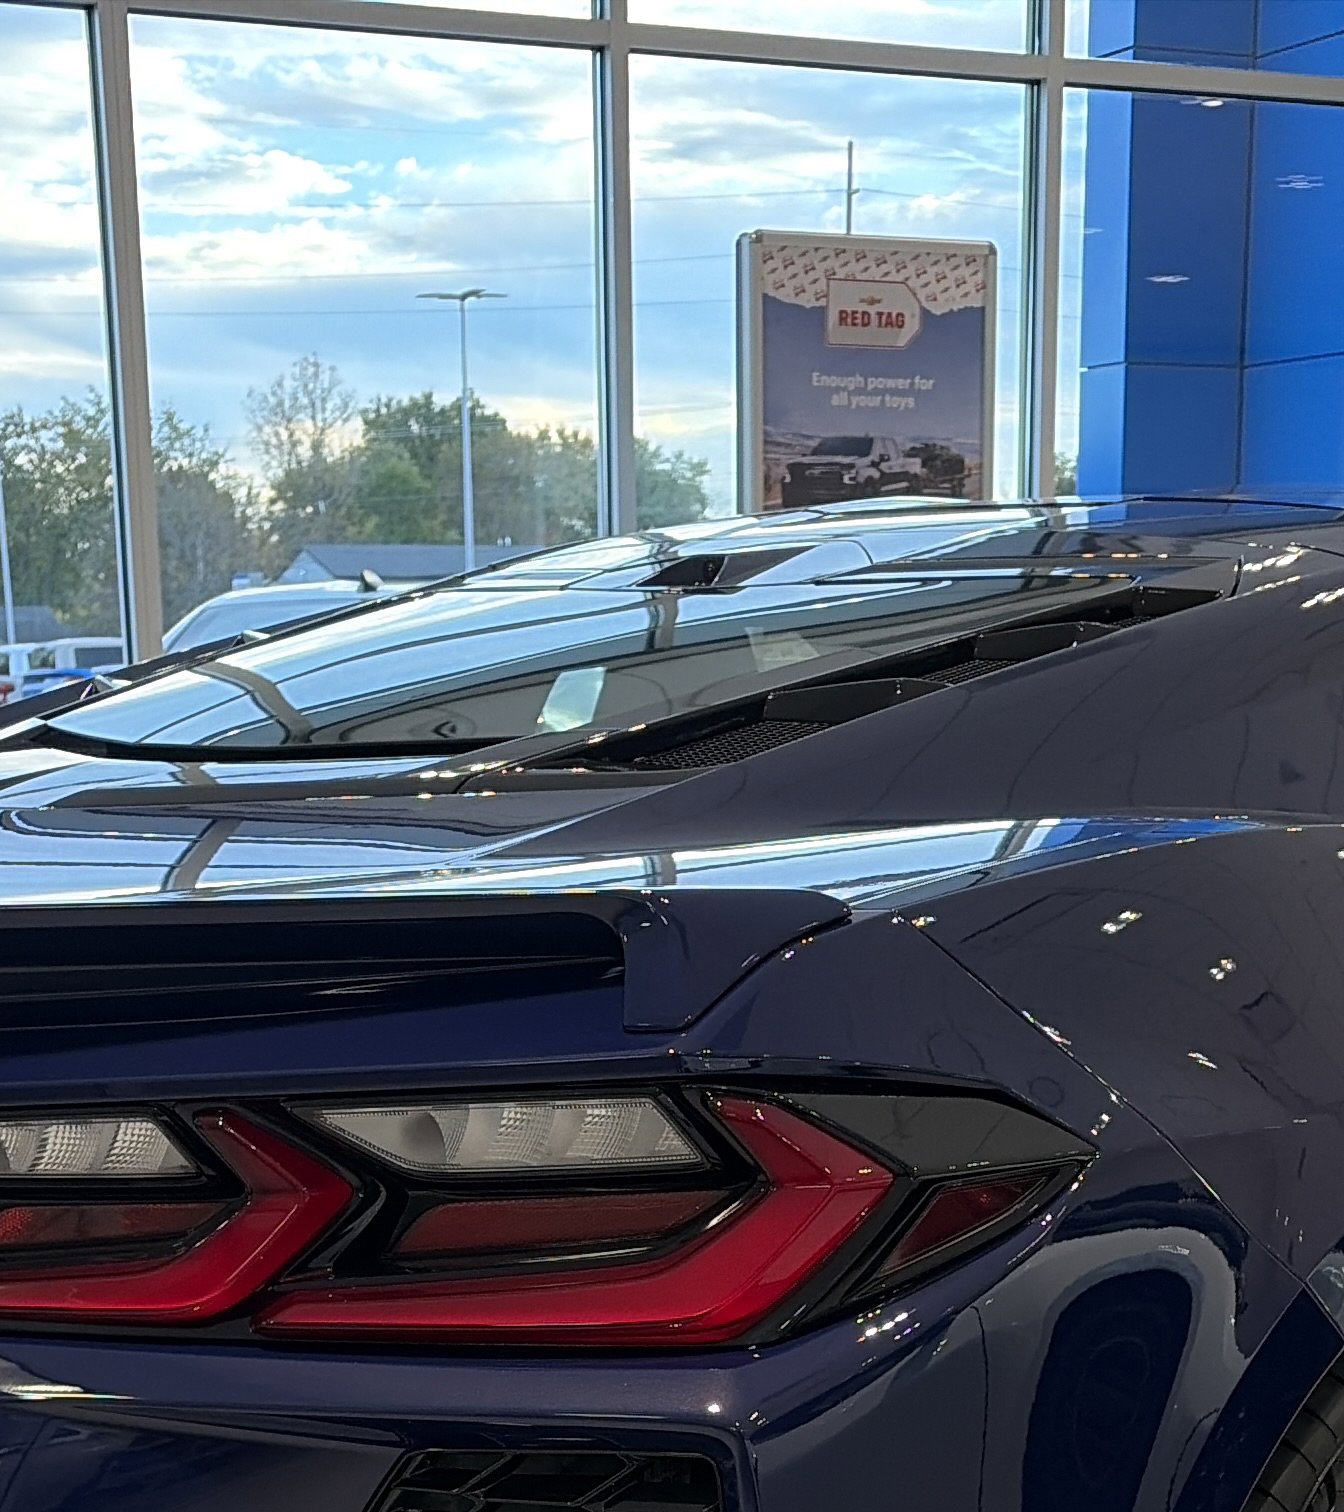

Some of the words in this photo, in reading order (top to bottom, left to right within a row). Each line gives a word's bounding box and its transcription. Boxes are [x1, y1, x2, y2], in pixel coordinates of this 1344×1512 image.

[838, 309, 871, 328] RED
[875, 311, 905, 329] TAG
[811, 371, 865, 391] Enough
[867, 375, 911, 392] power
[914, 374, 935, 390] for
[830, 391, 848, 407] all
[849, 394, 882, 410] your
[883, 393, 915, 410] toys
